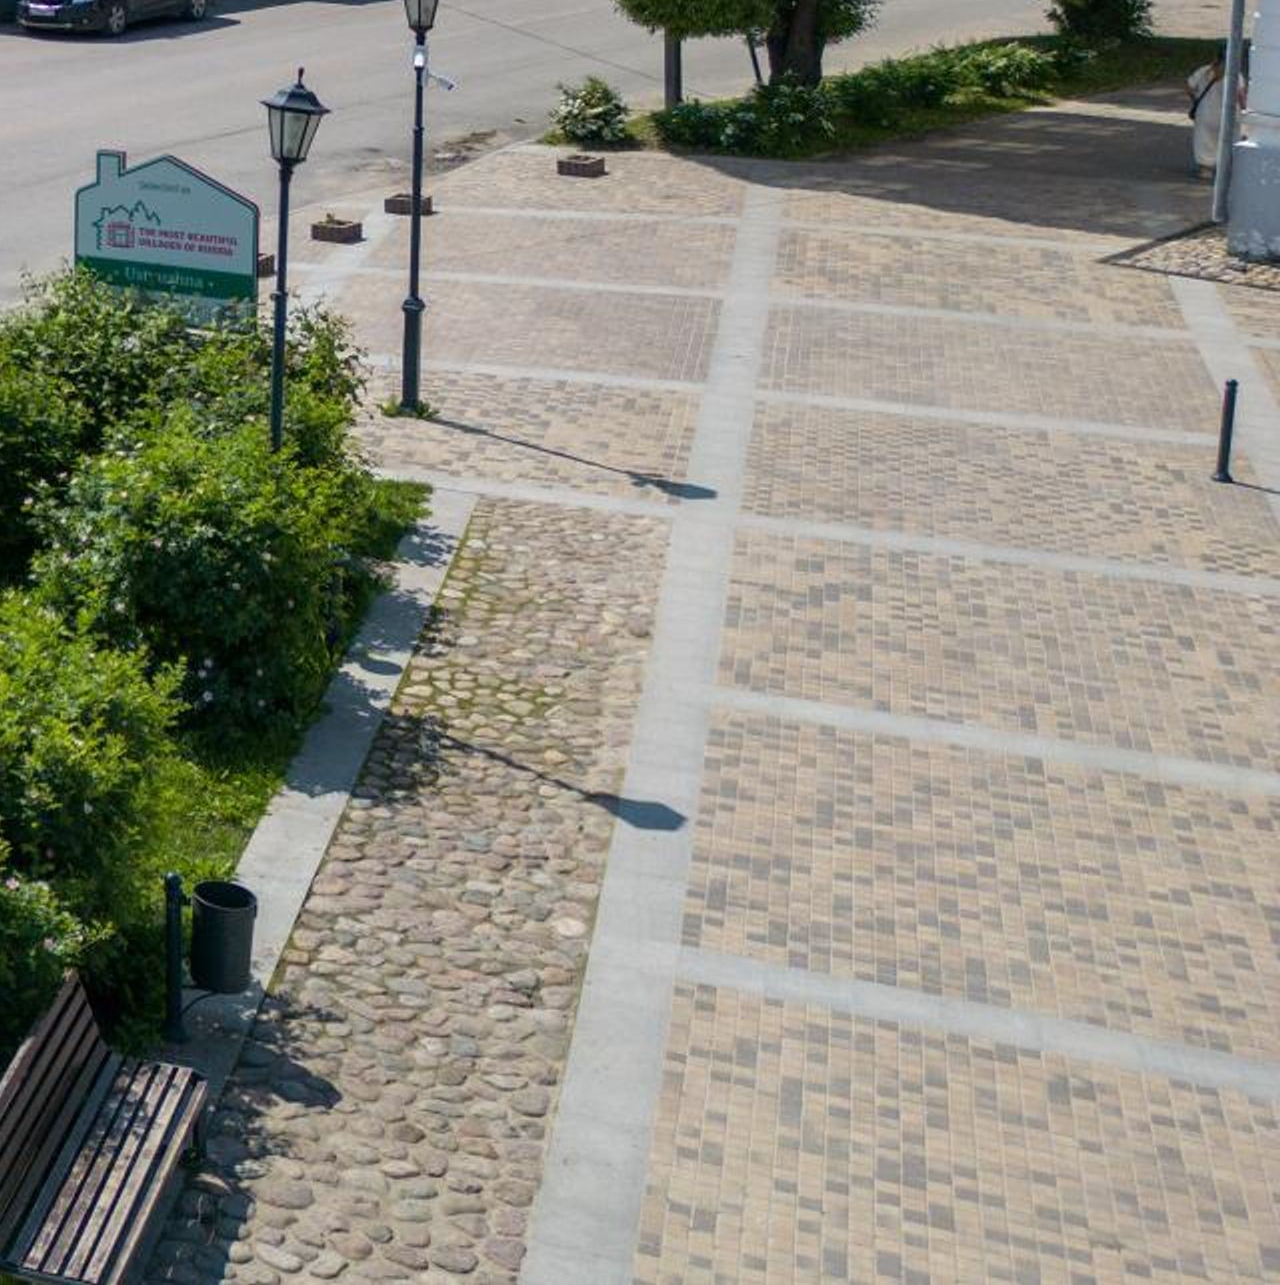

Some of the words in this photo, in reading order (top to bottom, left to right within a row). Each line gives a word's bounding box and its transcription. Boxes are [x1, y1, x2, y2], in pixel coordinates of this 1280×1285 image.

[139, 227, 156, 236] THE
[158, 229, 185, 241] MOST
[188, 233, 237, 246] BEAUTIFUL
[138, 238, 182, 251] VILLAGES
[184, 243, 196, 252] OF
